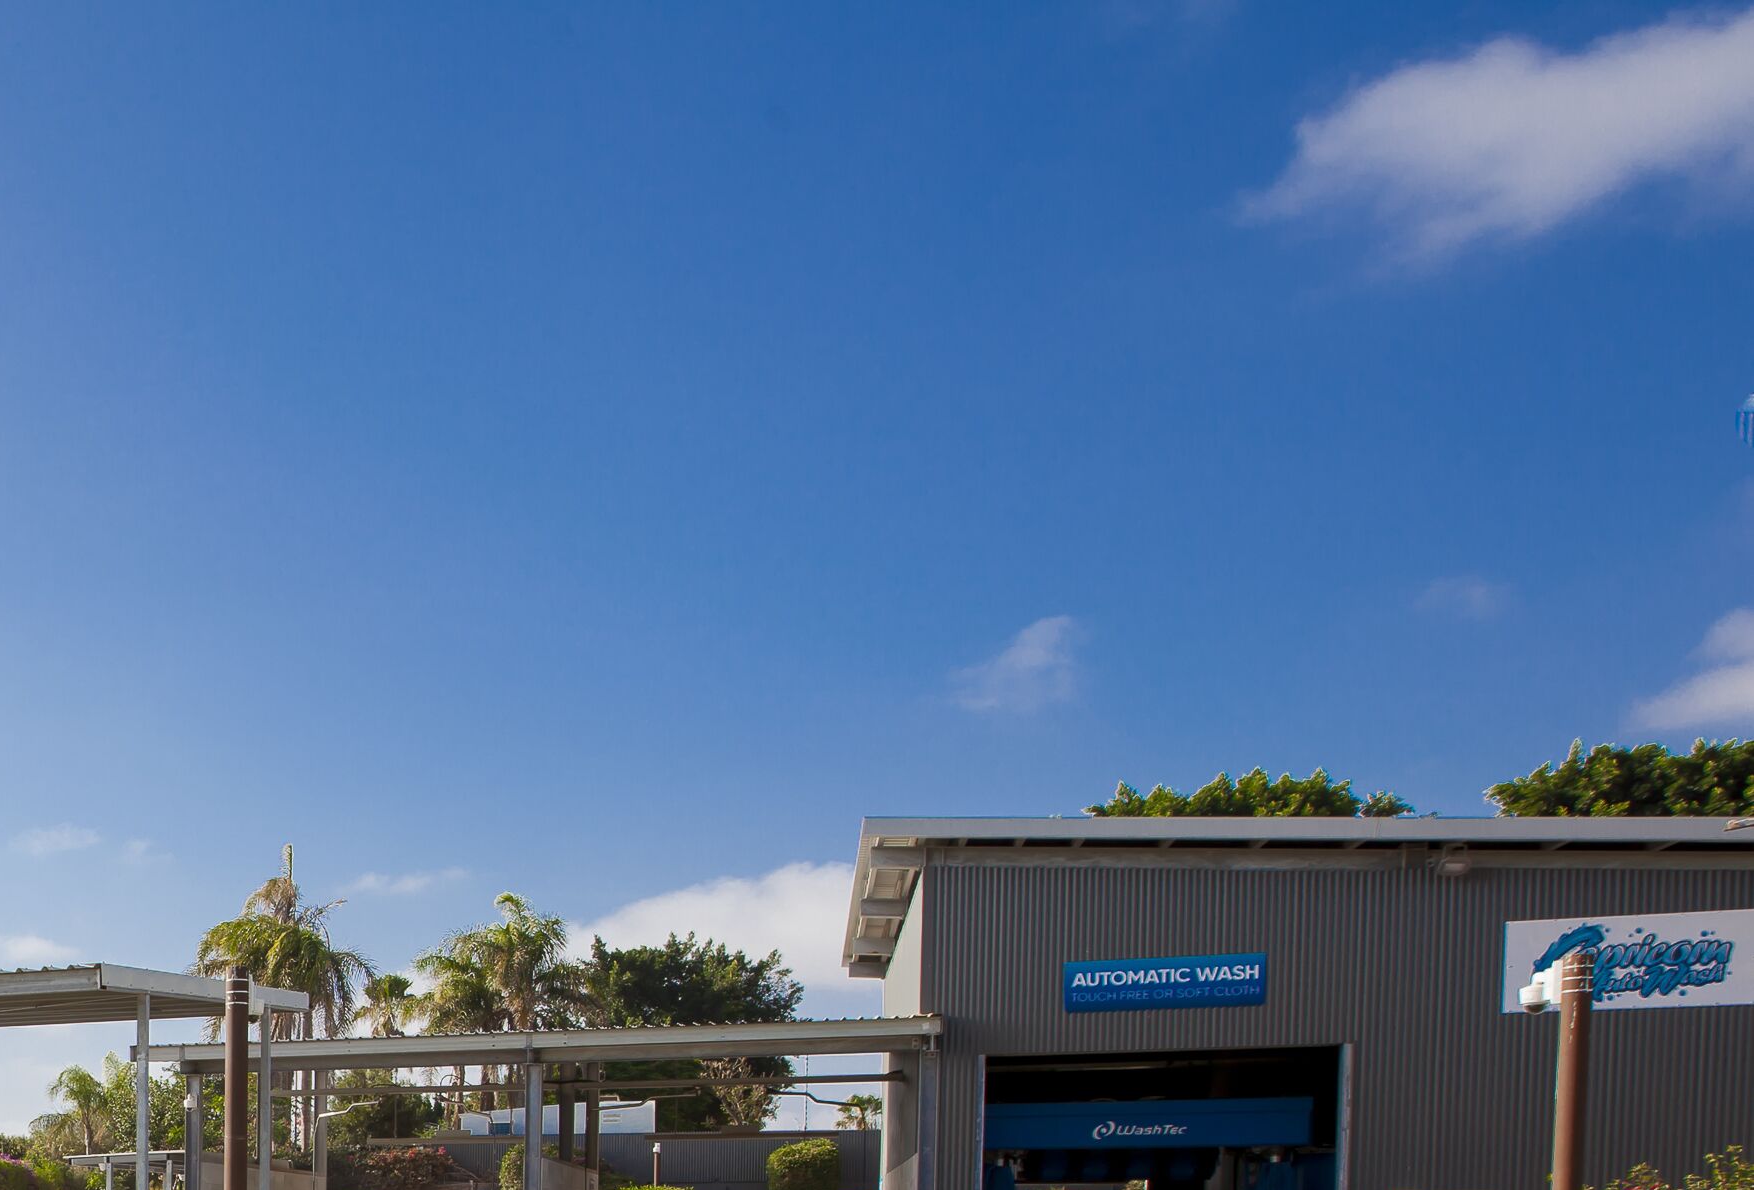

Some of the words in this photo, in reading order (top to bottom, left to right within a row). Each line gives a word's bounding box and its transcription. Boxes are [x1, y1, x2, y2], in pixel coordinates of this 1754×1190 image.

[1532, 924, 1732, 973] Cpricorn
[1071, 968, 1190, 987] AUTOMATIC
[1196, 964, 1260, 981] WASH
[1072, 991, 1117, 1002] TOUCH
[1120, 989, 1149, 1000] FREE
[1154, 988, 1174, 998] OR
[1177, 987, 1210, 998] SOFT
[1214, 985, 1260, 997] CLOTH
[1117, 1124, 1187, 1136] WashTec
